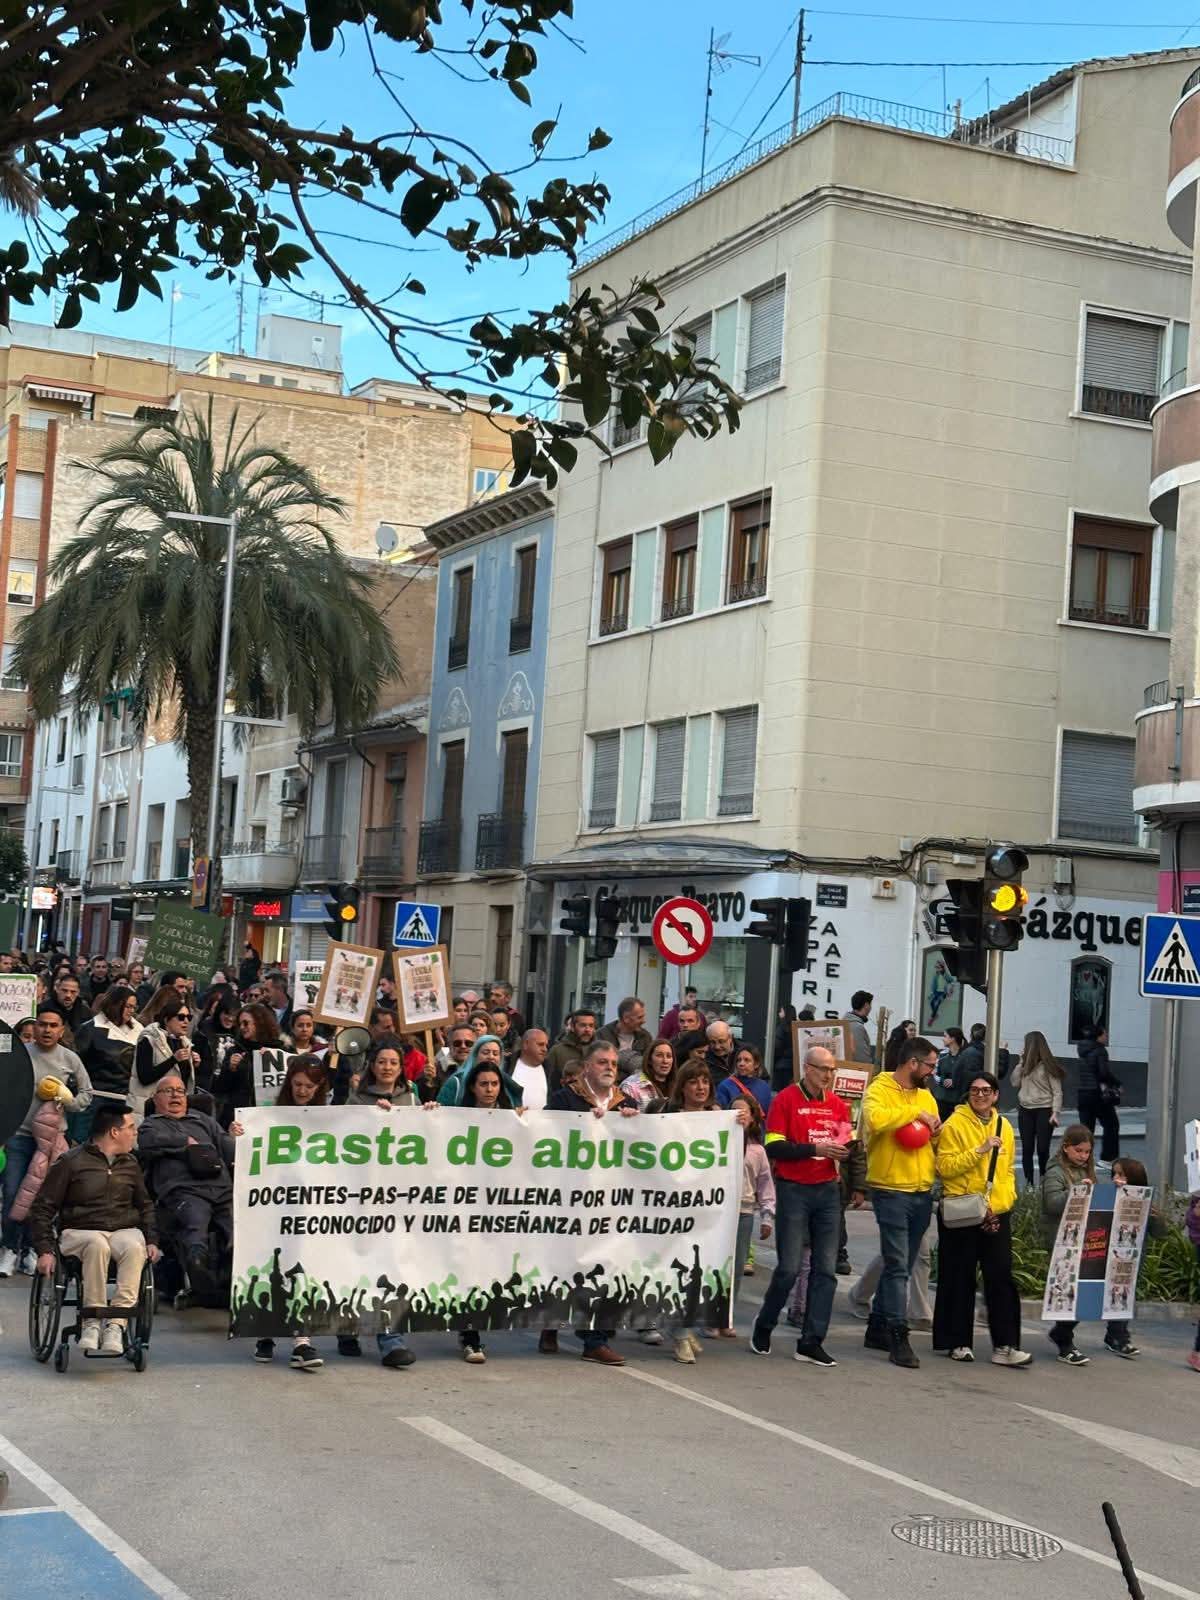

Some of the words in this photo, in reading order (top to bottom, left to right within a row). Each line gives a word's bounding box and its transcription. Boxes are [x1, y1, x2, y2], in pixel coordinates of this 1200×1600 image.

[837, 1078, 847, 1089] 31
[248, 1125, 428, 1175] ¡Basta
[447, 1126, 513, 1168] de
[531, 1129, 730, 1171] abusos!
[454, 1186, 478, 1204] DE
[486, 1187, 562, 1206] VILLENA
[570, 1189, 604, 1208] POR
[611, 1188, 634, 1206] UN
[641, 1187, 725, 1208] TRABAJO
[280, 1215, 396, 1235] RECONOCIDO
[403, 1215, 416, 1232] Y
[422, 1215, 461, 1233] UNA
[468, 1210, 582, 1235] ENSEÑANZA
[588, 1216, 609, 1235] DE
[616, 1216, 695, 1235] CALIDAD
